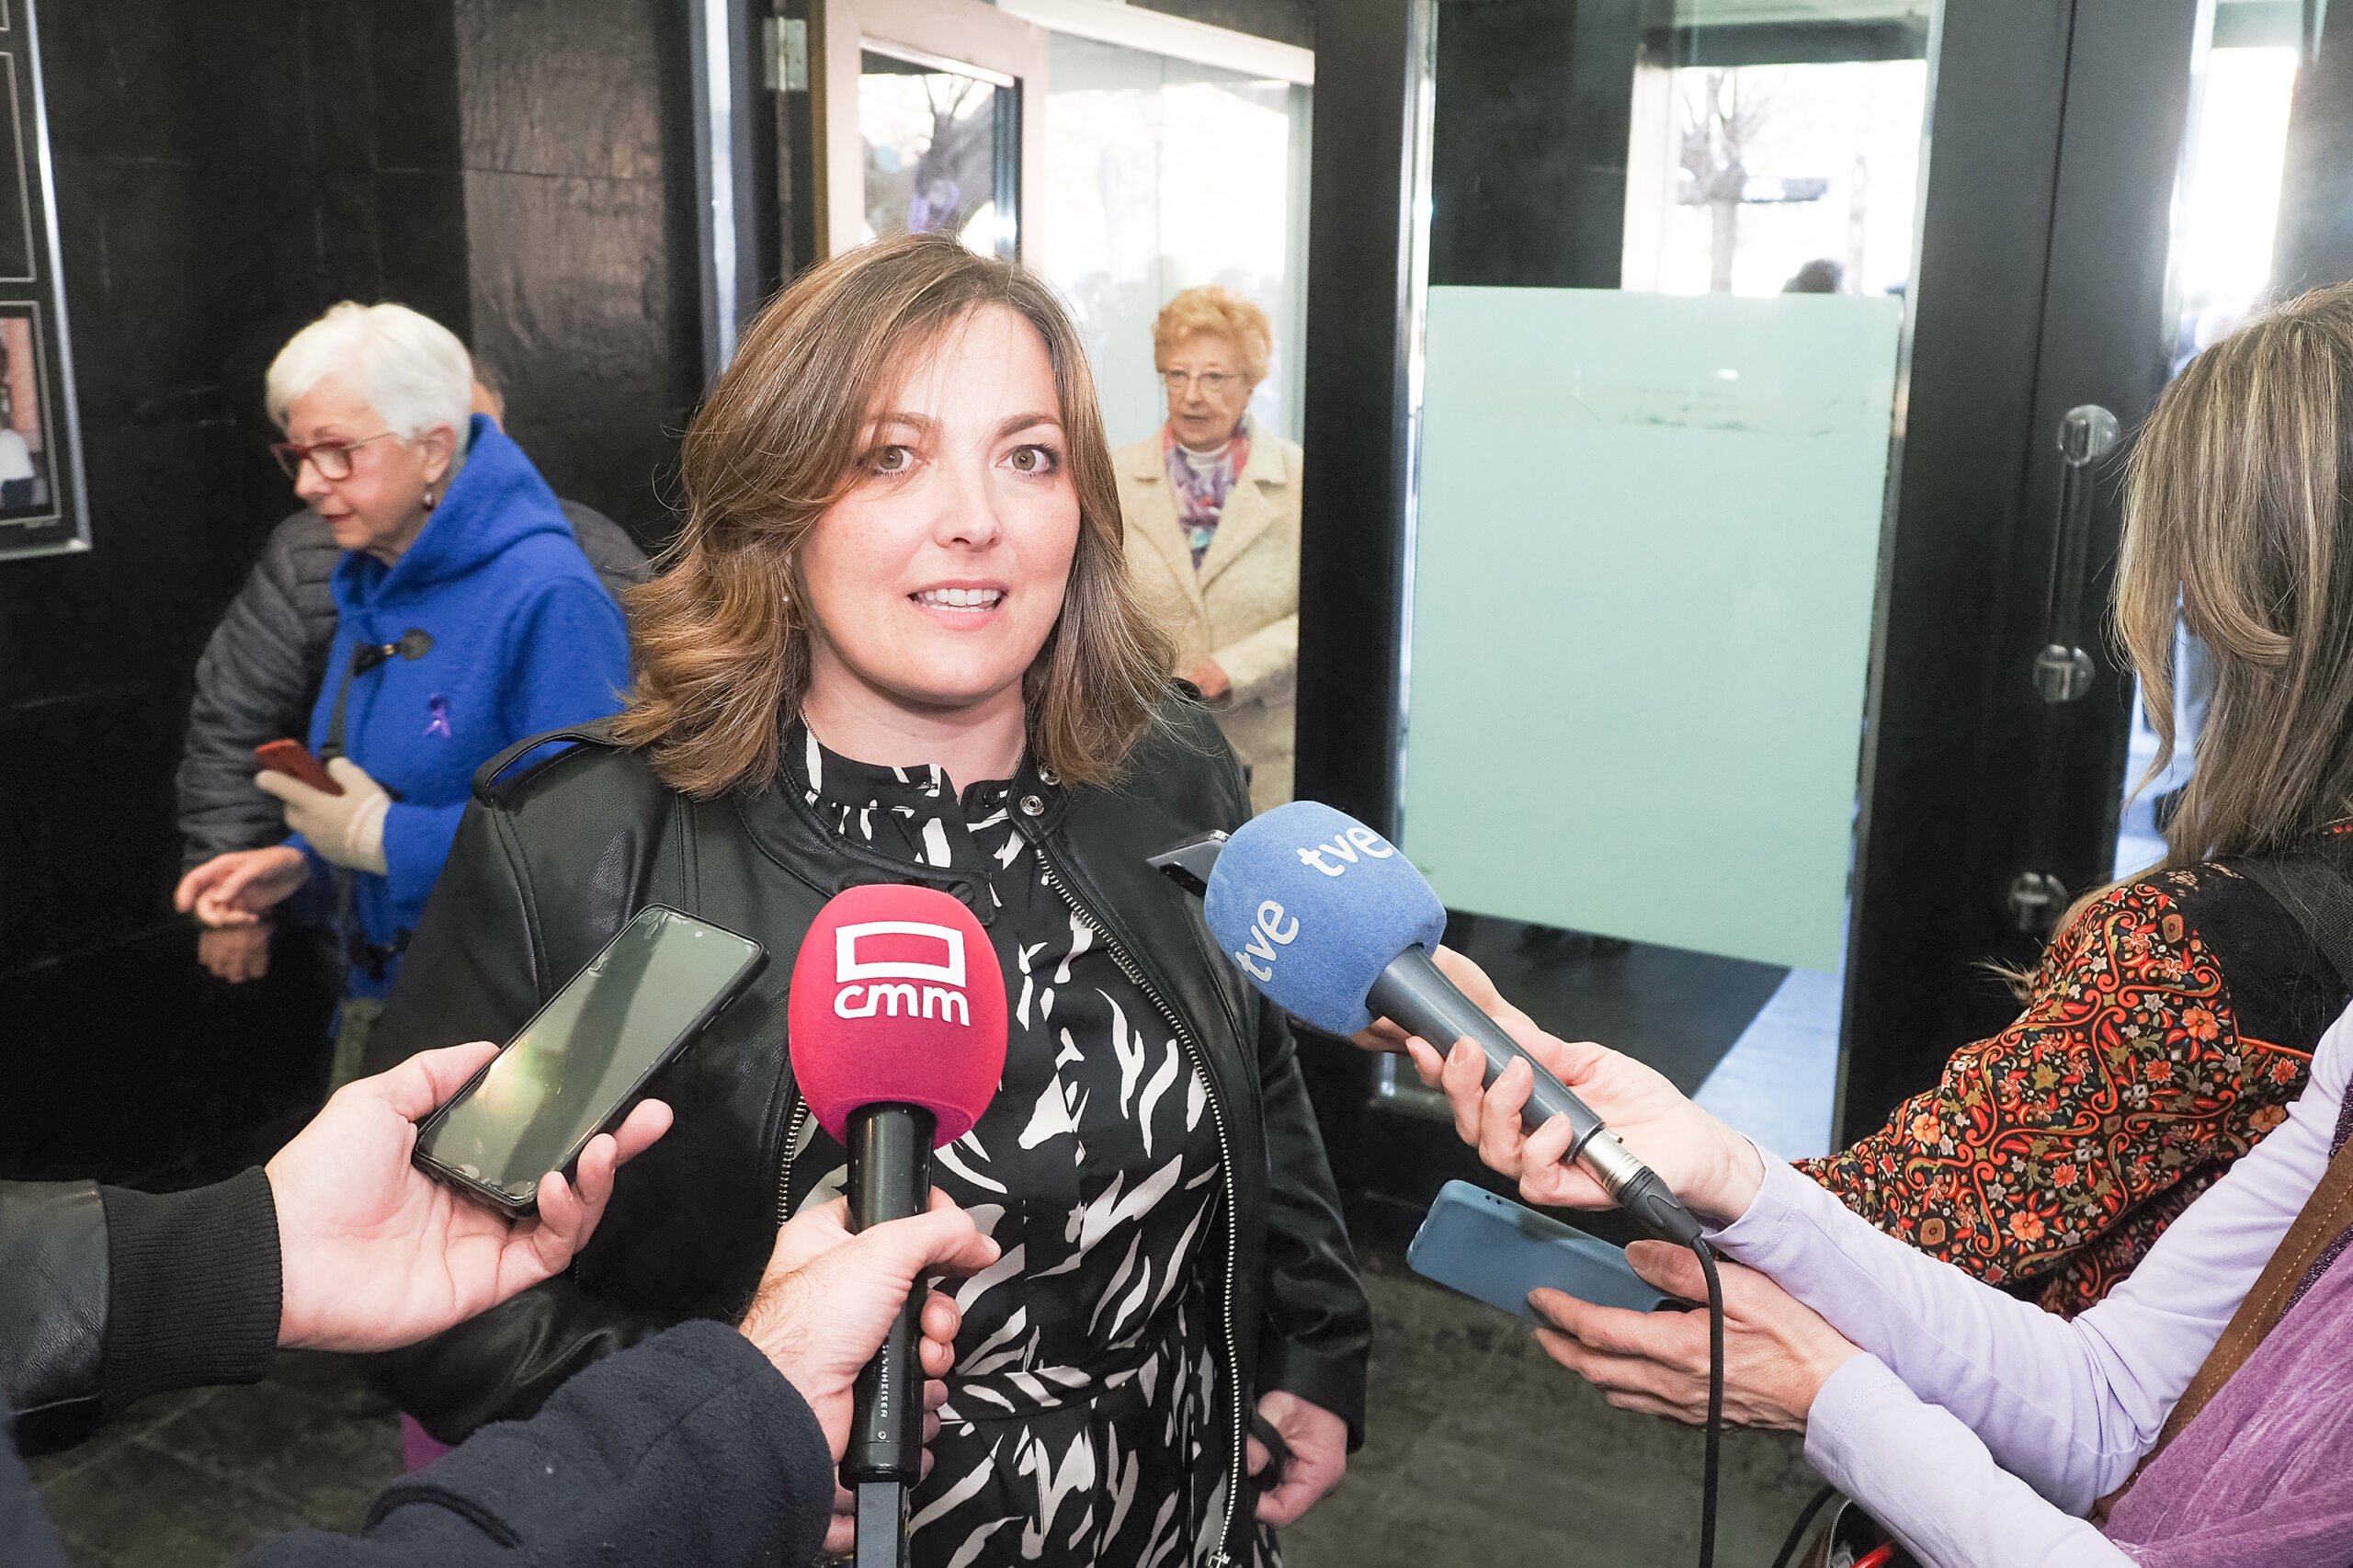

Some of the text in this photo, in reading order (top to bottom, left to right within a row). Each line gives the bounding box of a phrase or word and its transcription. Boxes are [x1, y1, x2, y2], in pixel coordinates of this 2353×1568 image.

[1296, 827, 1393, 877] tve
[1235, 900, 1300, 983] tve
[834, 983, 971, 1027] cmm
